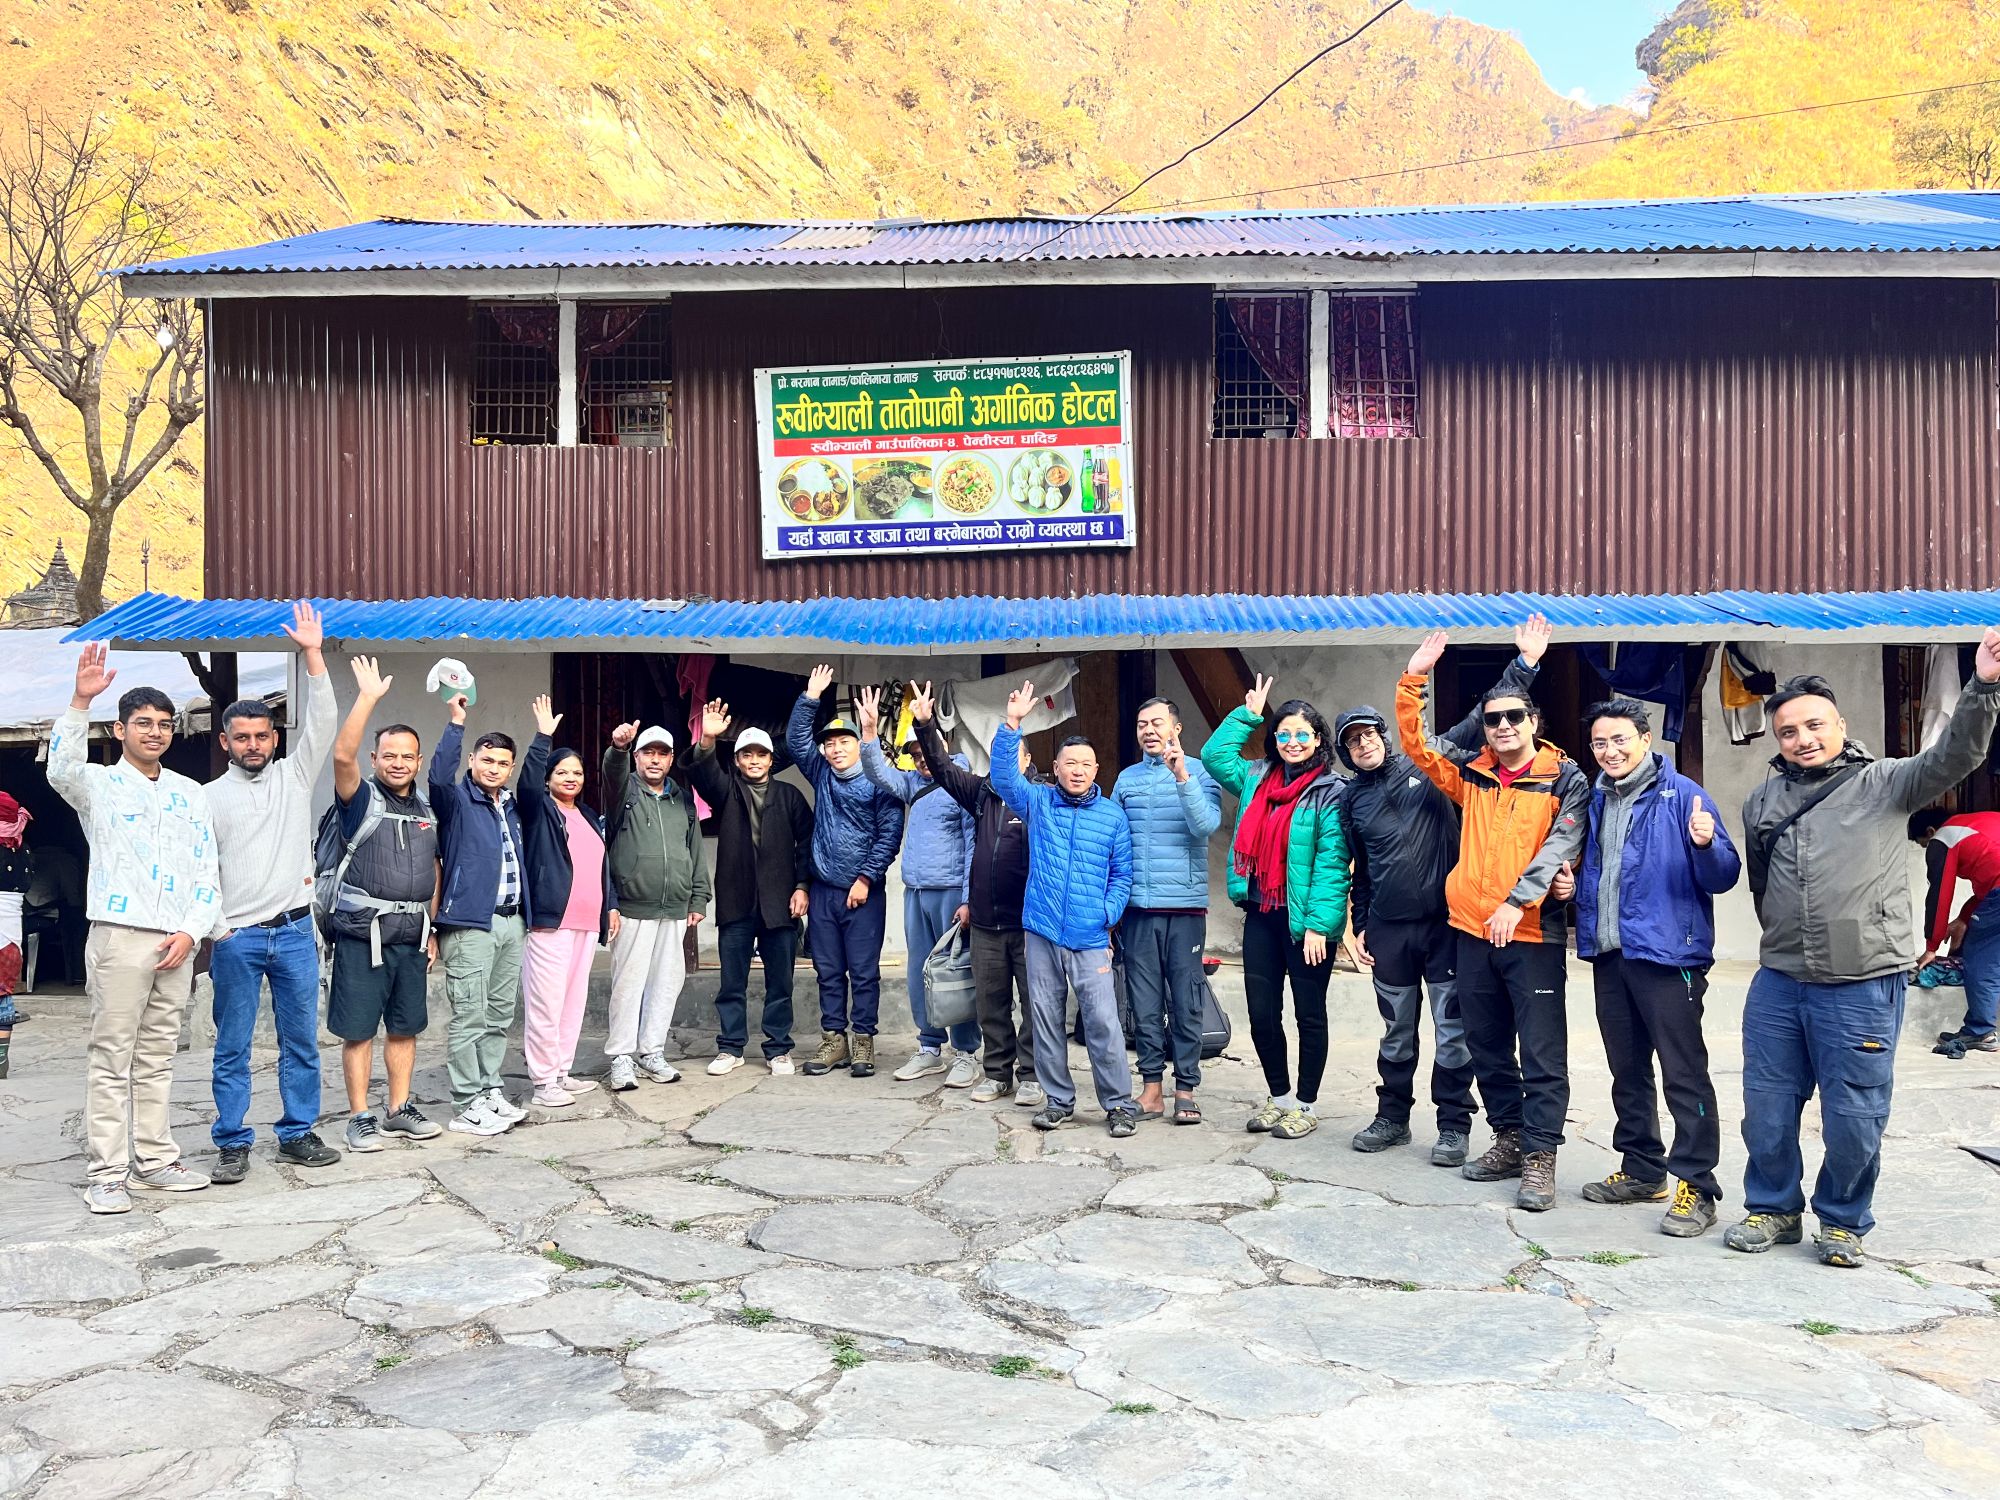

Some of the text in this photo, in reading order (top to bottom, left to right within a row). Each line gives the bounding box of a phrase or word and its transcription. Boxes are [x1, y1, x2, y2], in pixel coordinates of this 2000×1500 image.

[879, 387, 964, 431] तातोपानी
[970, 383, 1056, 426] अर्गानिक
[1061, 381, 1117, 425] होटल
[788, 527, 814, 547] यहाँ
[817, 530, 850, 546] खाना
[854, 529, 864, 544] र
[867, 528, 902, 544] खाजा
[905, 527, 931, 542] तथा
[1006, 520, 1035, 540] राम्रो
[1038, 522, 1087, 537] व्यवस्था
